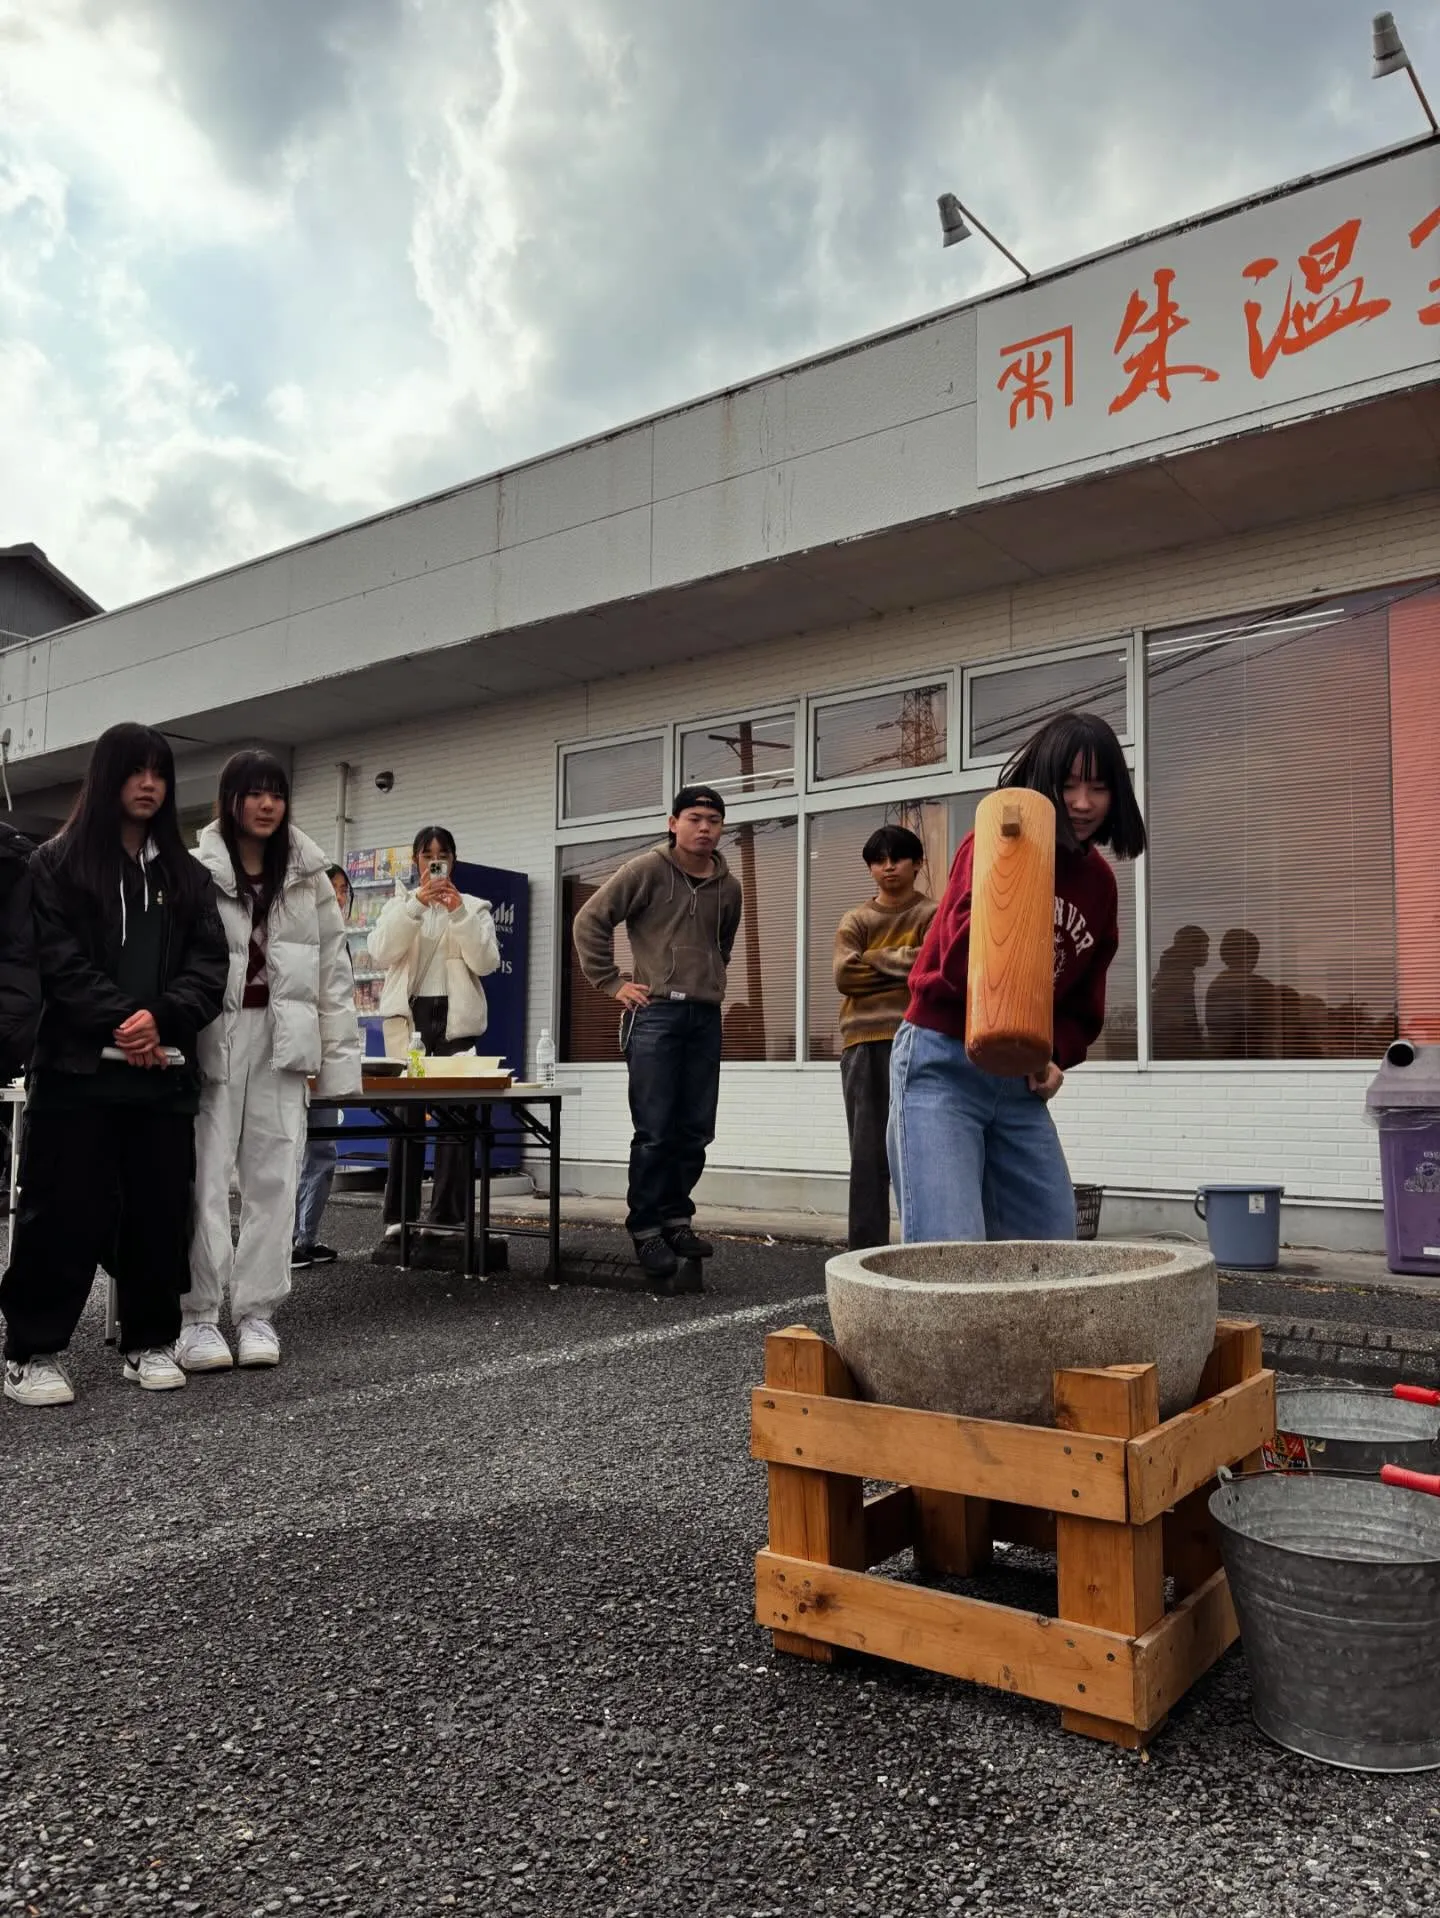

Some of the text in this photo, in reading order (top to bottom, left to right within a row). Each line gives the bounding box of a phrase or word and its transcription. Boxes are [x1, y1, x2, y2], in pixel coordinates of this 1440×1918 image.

[1108, 205, 1440, 416] 朱温
[492, 901, 515, 925] ahi
[1054, 895, 1094, 957] NVER
